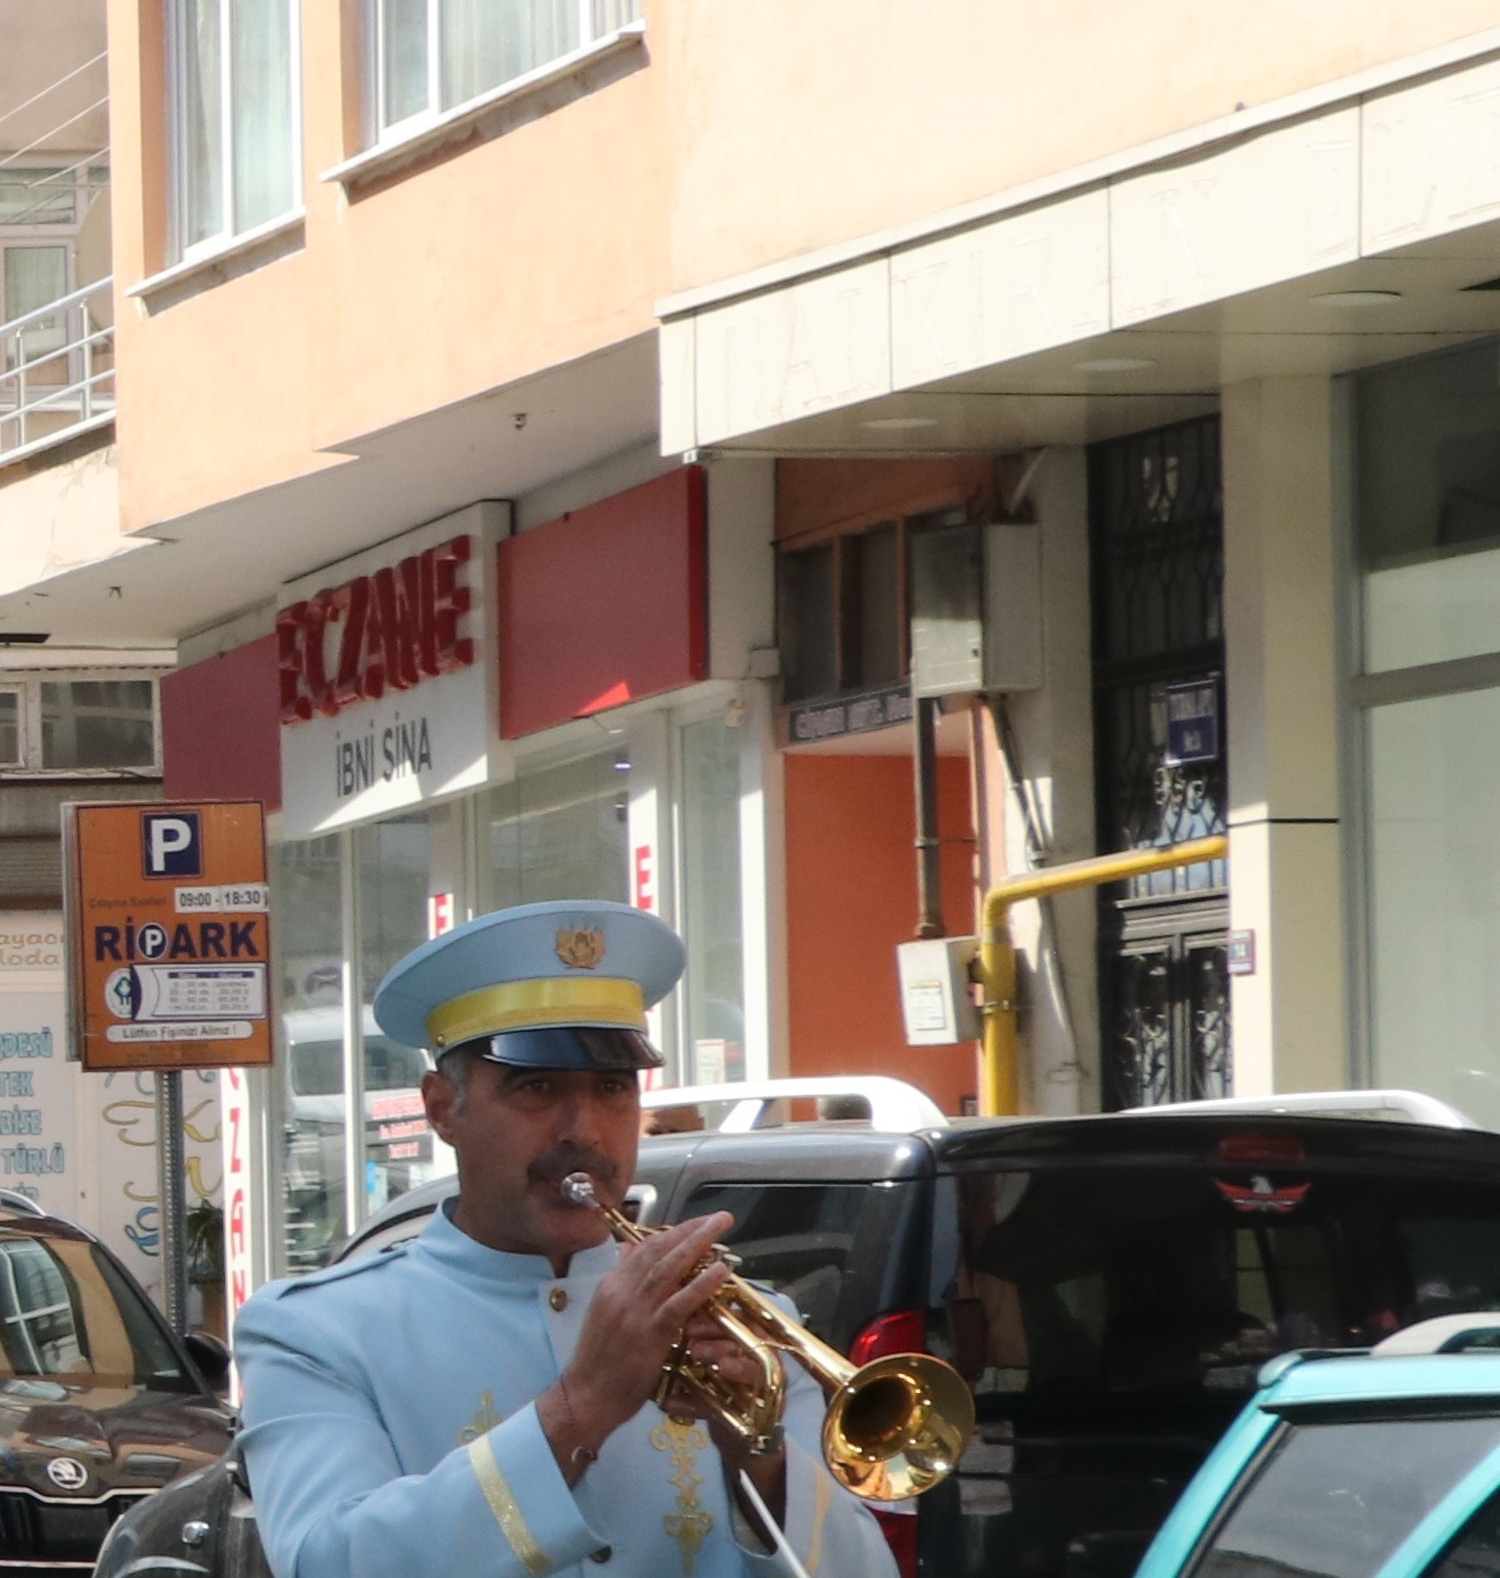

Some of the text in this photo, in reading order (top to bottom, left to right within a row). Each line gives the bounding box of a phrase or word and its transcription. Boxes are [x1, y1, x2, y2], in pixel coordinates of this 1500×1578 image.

[278, 533, 474, 723] ECZANE
[336, 711, 433, 798] İBNİ SİNA
[151, 818, 192, 872] P
[179, 892, 212, 907] 09:00
[224, 890, 261, 905] 18:30
[94, 915, 260, 962] RİPARK
[0, 1142, 65, 1176] TÜRLÜ
